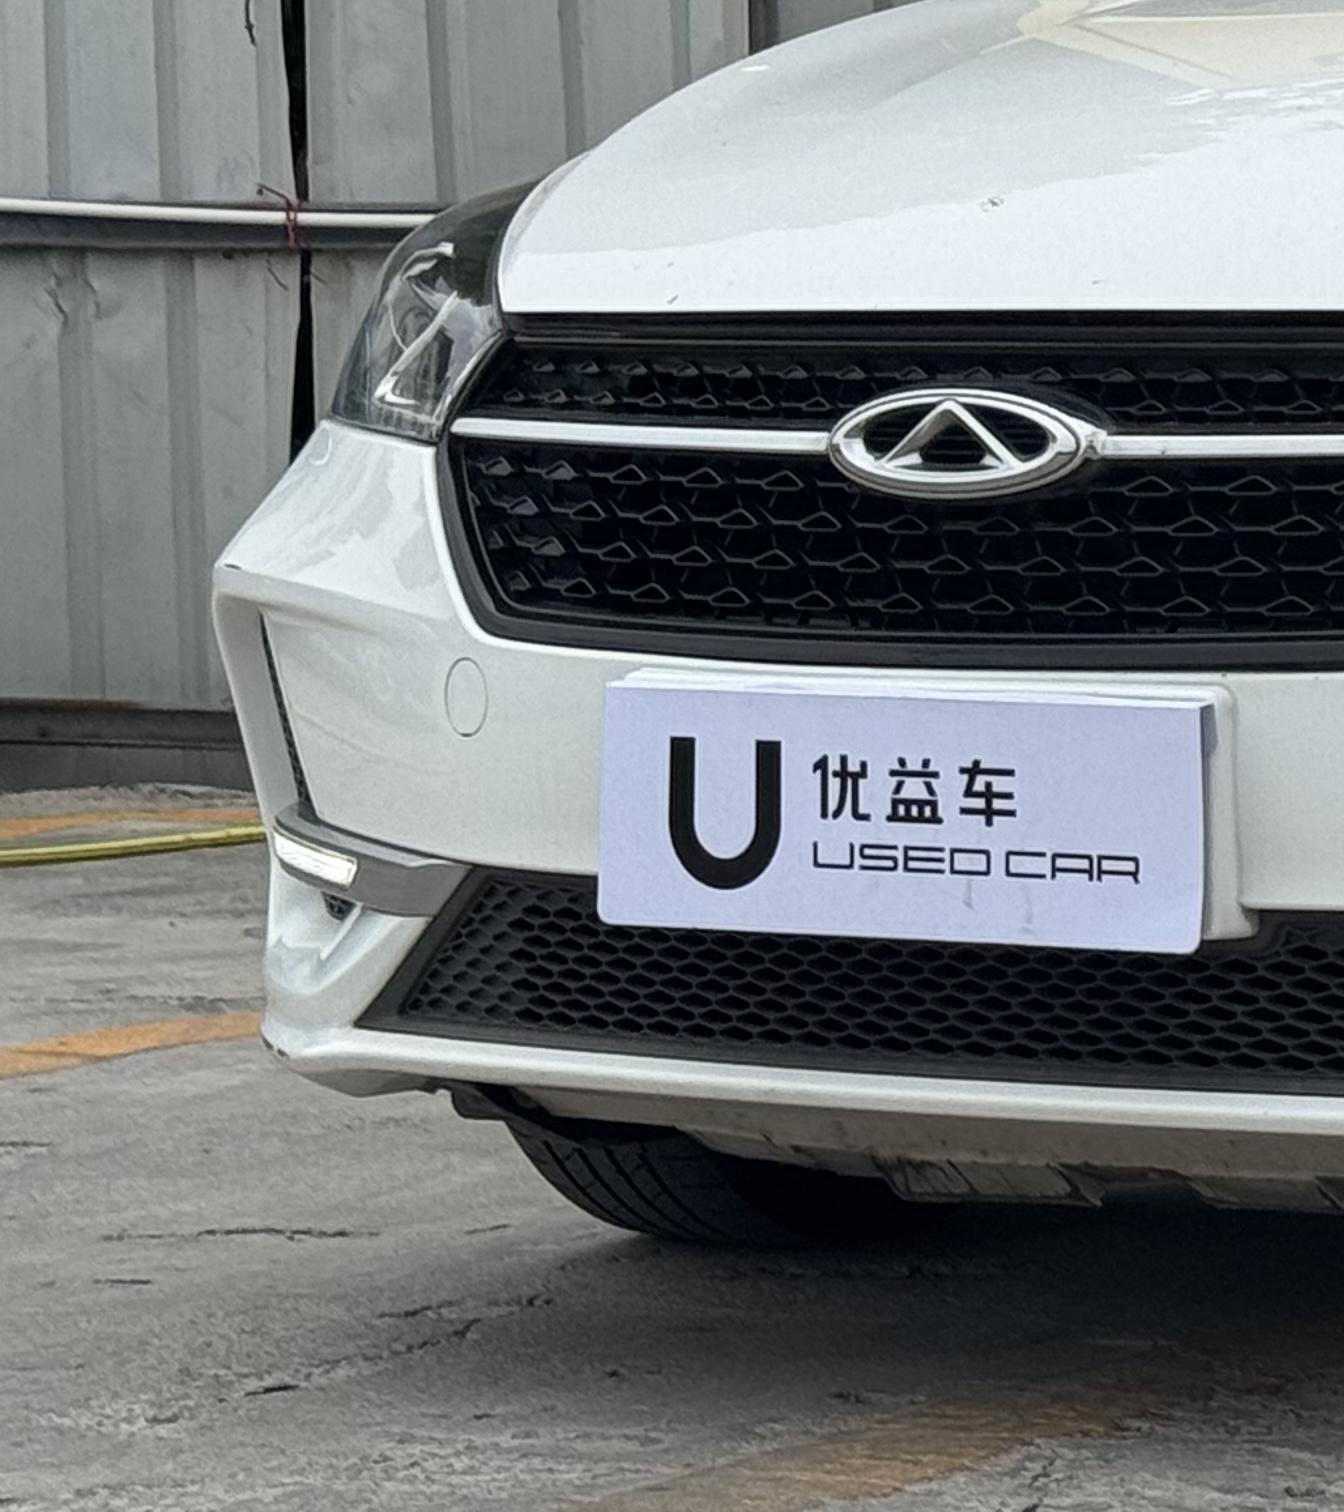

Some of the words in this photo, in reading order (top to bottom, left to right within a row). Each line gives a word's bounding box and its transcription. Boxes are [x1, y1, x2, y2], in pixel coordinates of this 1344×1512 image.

[669, 736, 782, 890] U
[812, 754, 1017, 827] 优益车
[812, 841, 991, 877] USED
[1004, 850, 1140, 885] CAR
